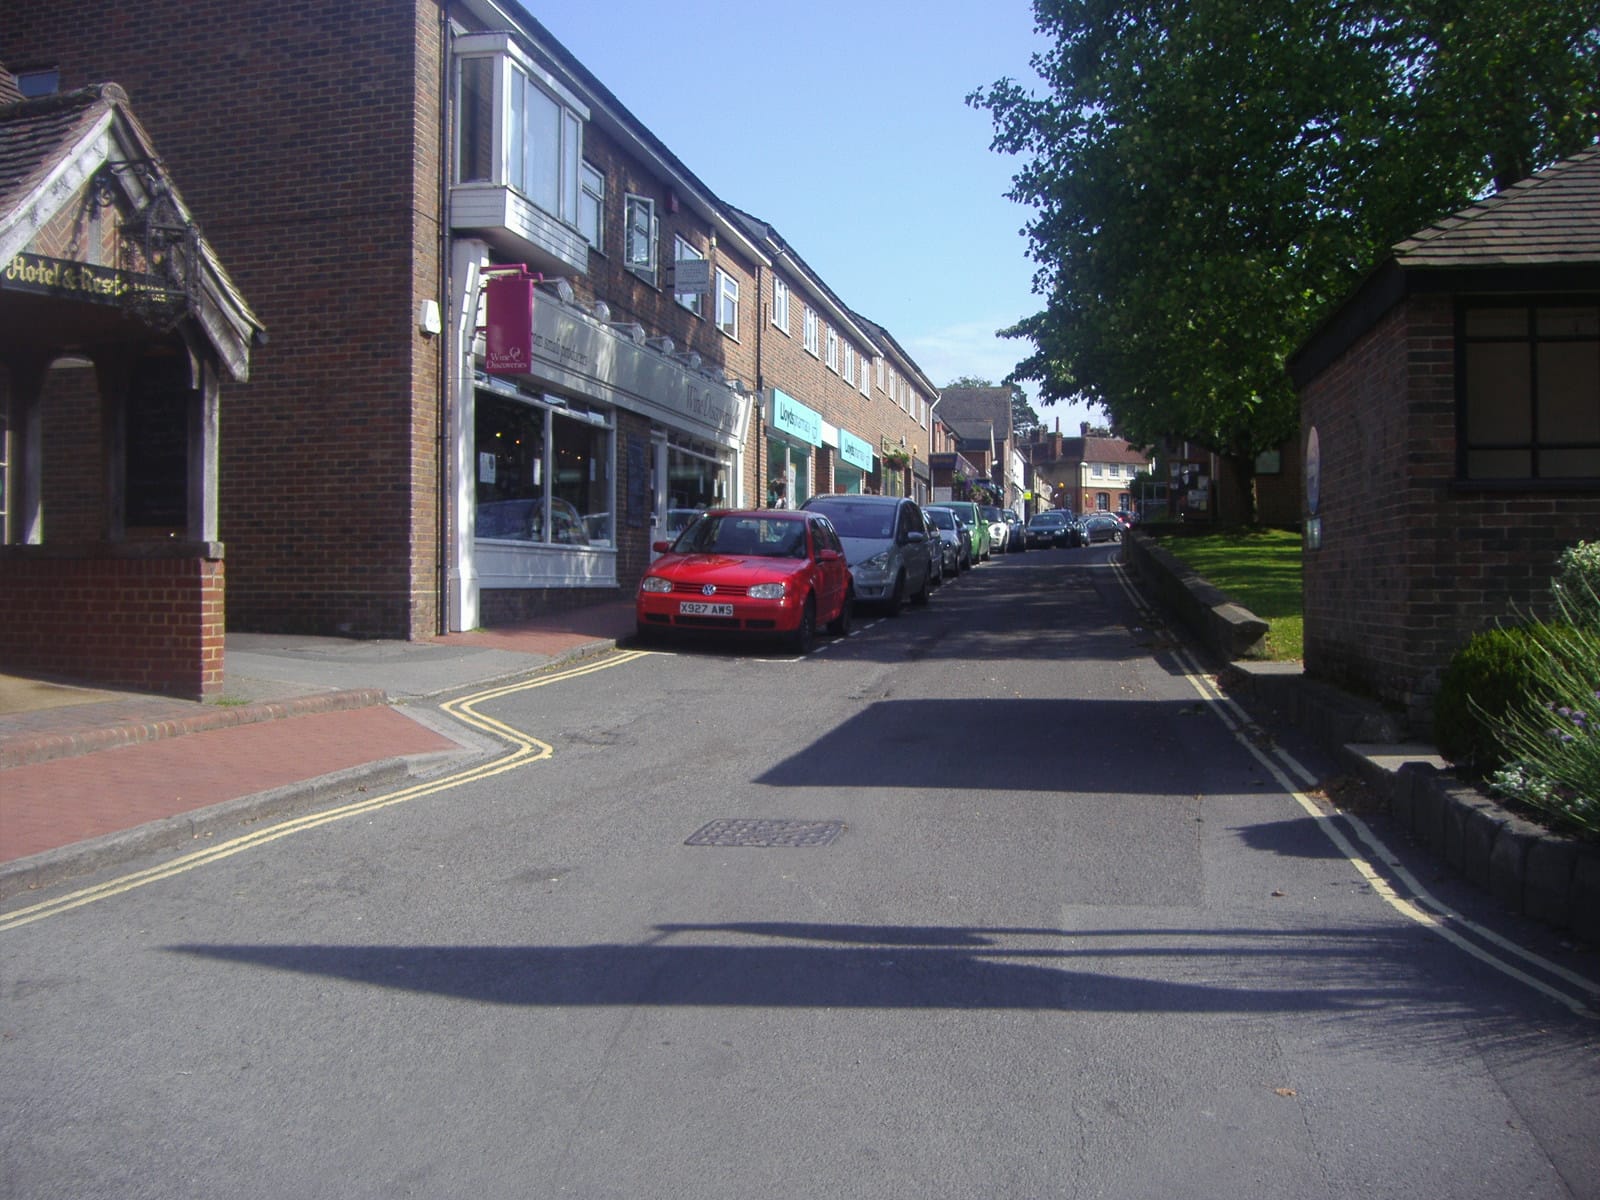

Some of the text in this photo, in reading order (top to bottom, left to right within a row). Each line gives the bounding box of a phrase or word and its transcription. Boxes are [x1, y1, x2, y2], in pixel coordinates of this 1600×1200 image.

[6, 255, 60, 287] Hotel
[62, 267, 77, 290] &
[490, 352, 511, 361] Wine
[486, 360, 528, 369] Discoveries
[681, 602, 733, 615] X927 AWS
